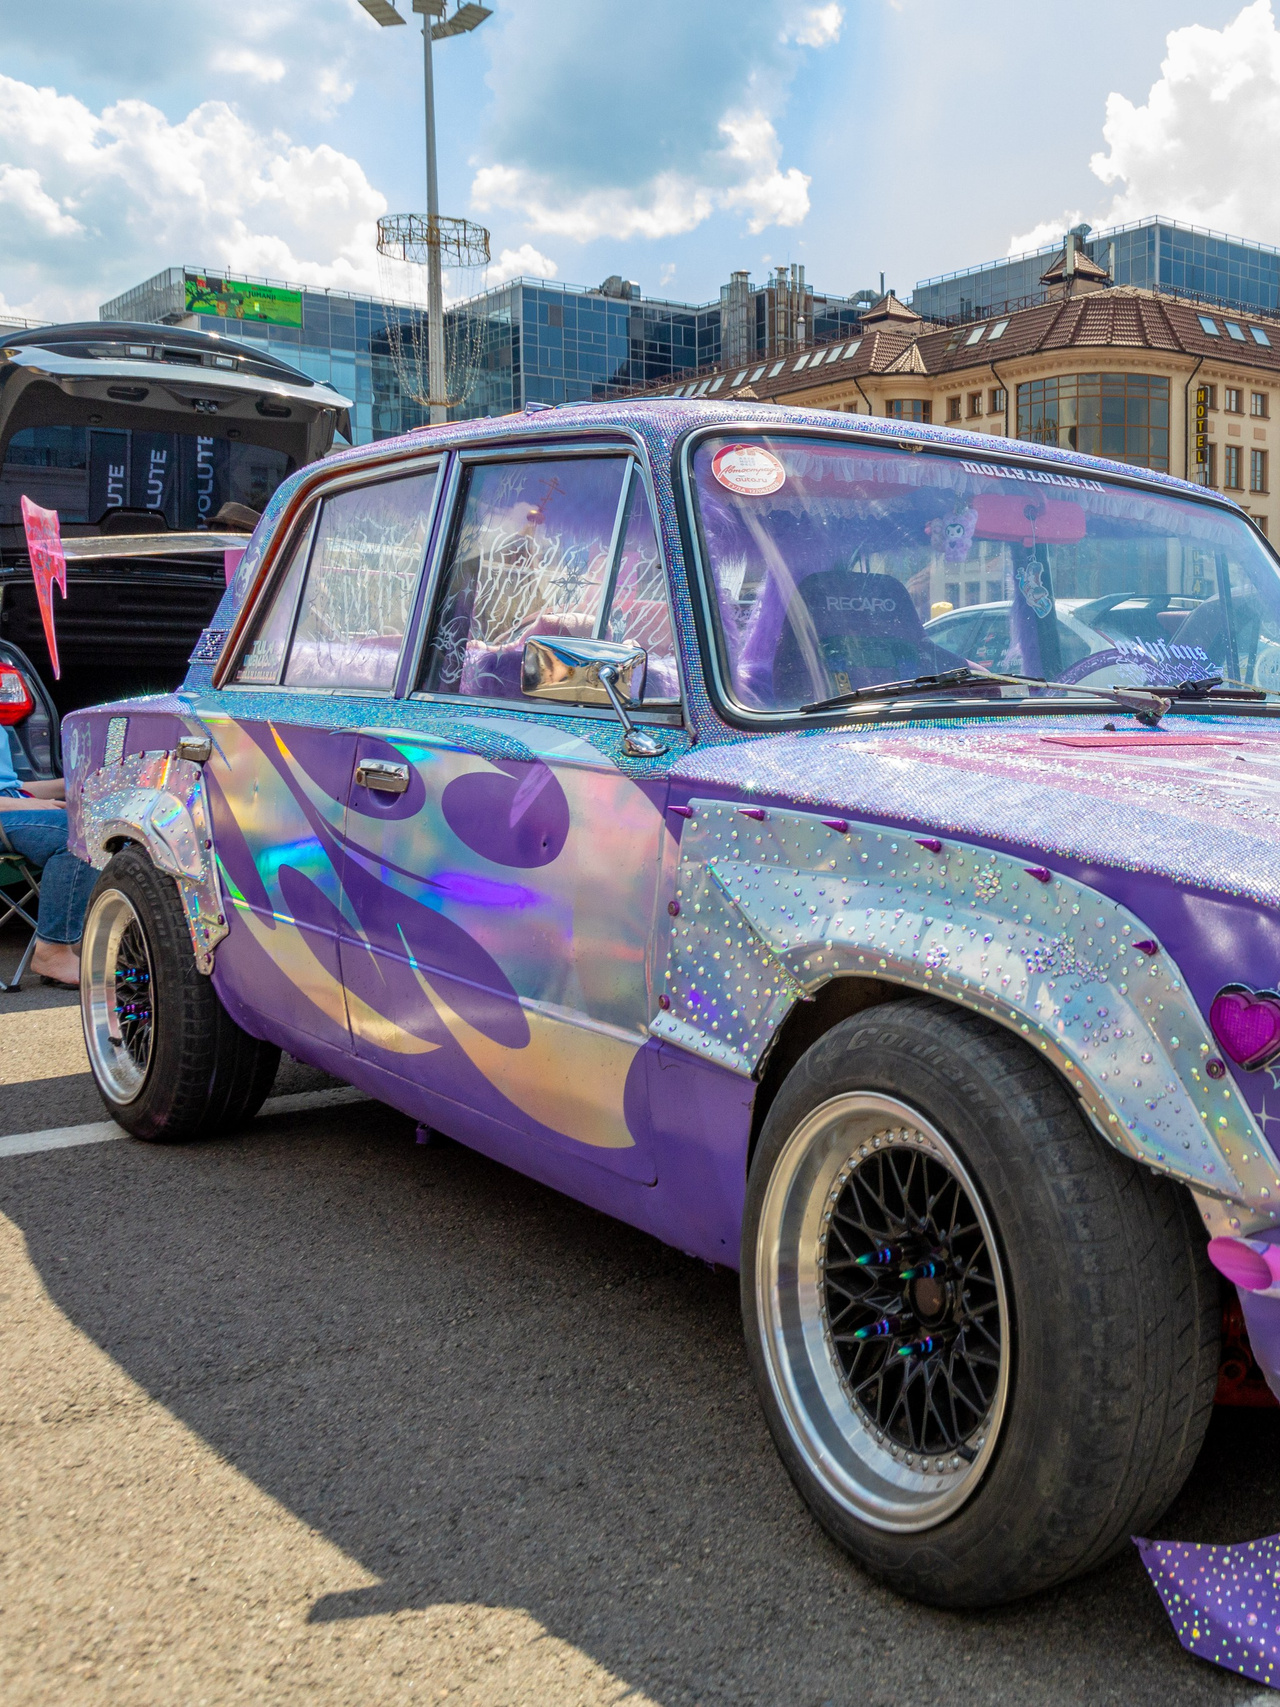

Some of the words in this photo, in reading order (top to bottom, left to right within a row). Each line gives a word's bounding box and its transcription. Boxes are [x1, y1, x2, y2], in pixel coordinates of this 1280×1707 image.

[1197, 389, 1205, 463] HOTEL
[826, 596, 896, 612] RECARO
[1114, 635, 1209, 663] onlyfans
